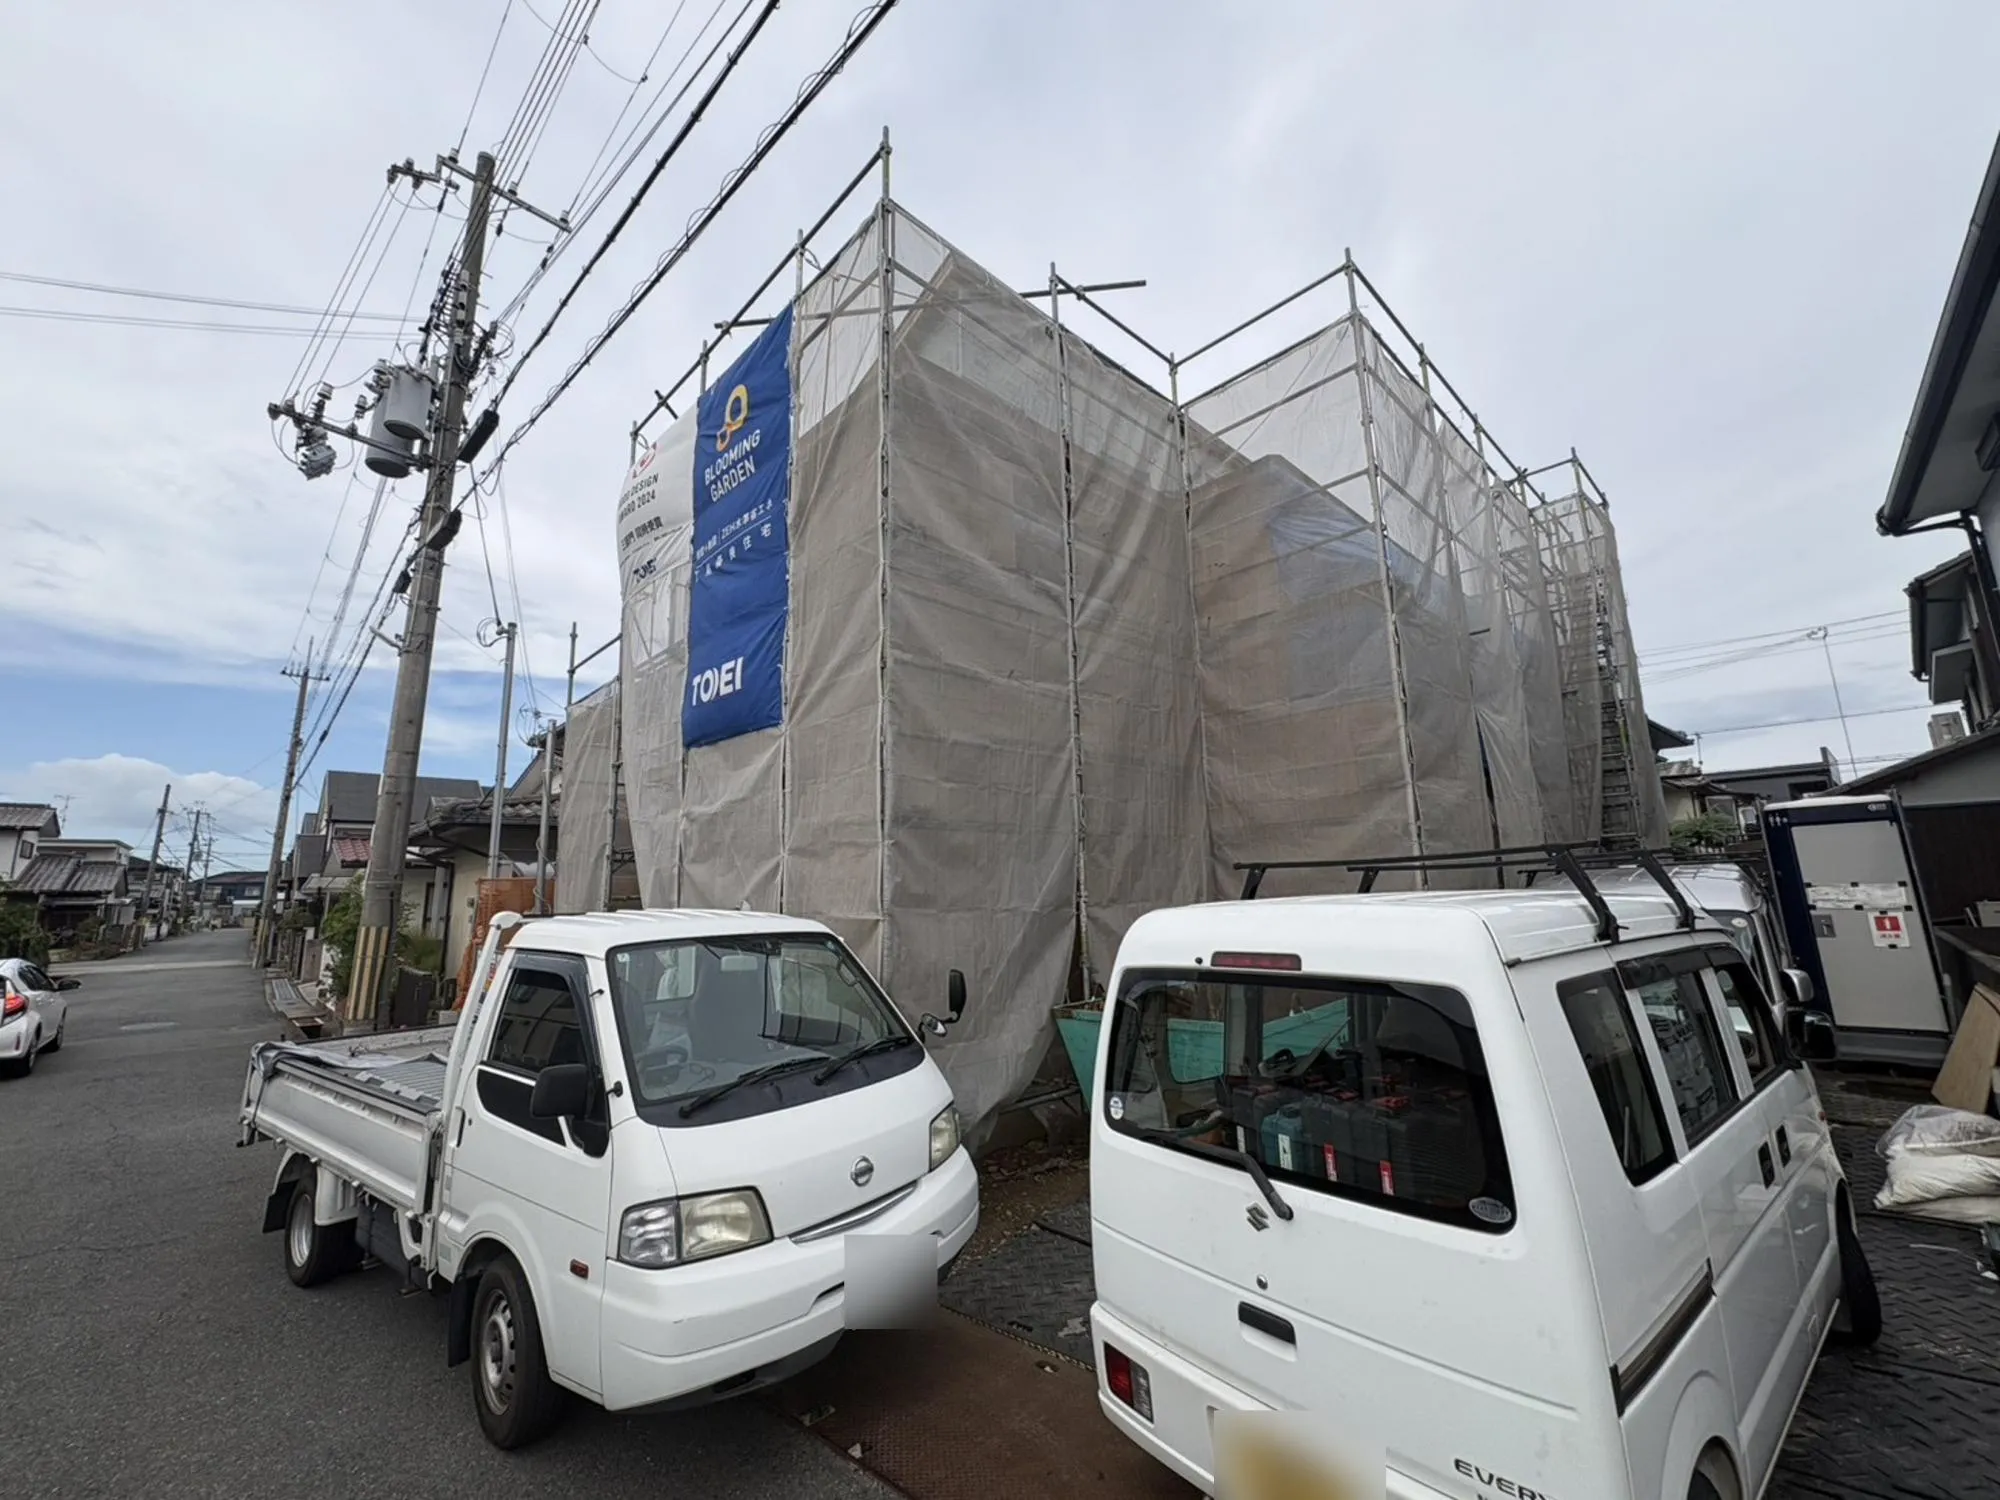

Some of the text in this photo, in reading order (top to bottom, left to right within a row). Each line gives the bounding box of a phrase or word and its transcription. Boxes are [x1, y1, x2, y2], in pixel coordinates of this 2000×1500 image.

[704, 429, 761, 486] BLOOMING
[710, 455, 756, 502] GARDEN
[630, 472, 659, 497] DESIGN
[637, 489, 656, 509] 2024
[692, 656, 744, 707] TOEI
